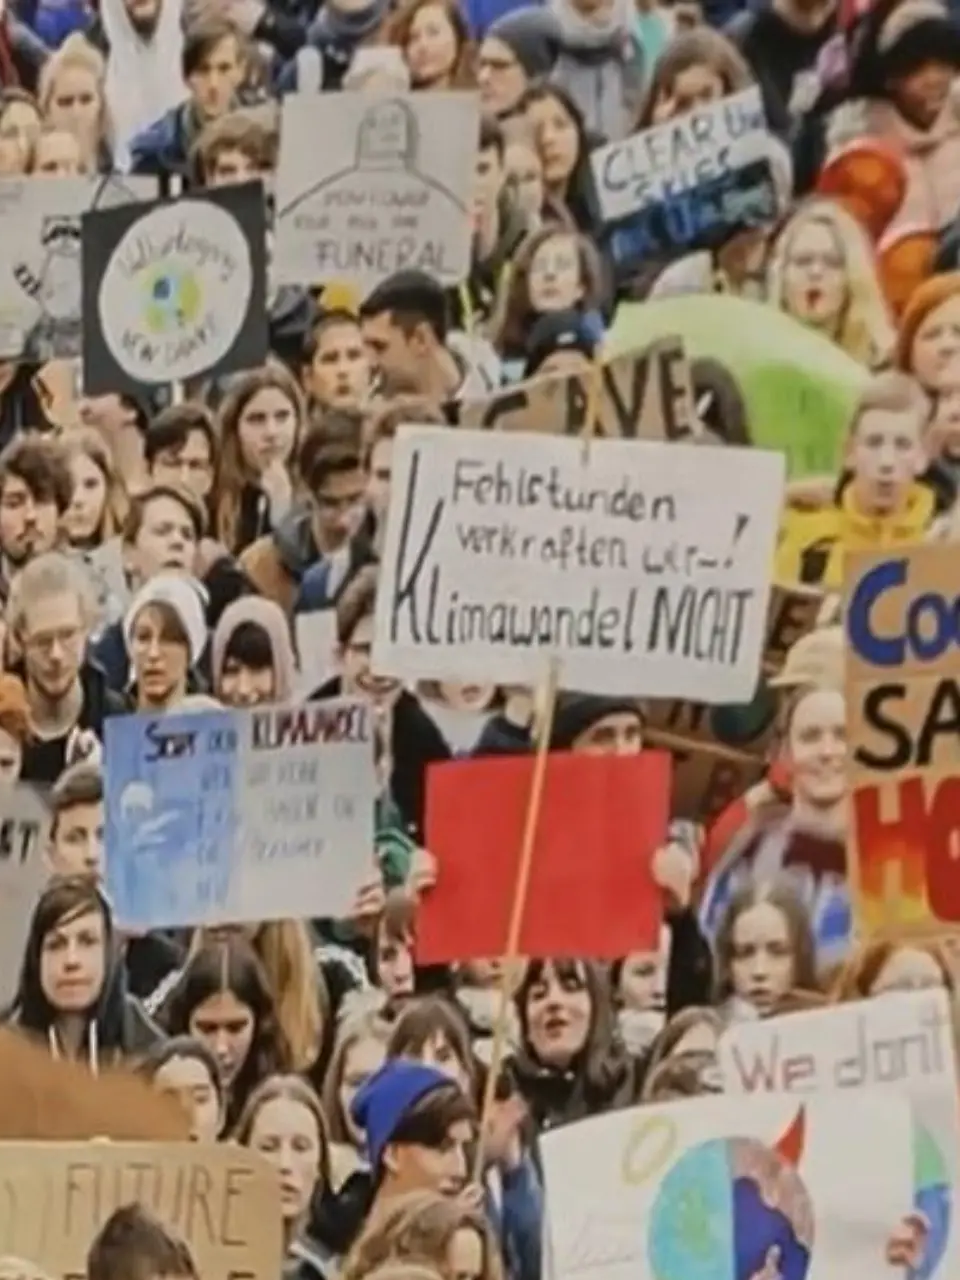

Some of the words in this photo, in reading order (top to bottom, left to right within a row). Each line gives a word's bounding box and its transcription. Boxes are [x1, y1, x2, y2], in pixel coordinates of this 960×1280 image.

[316, 238, 458, 273] FUNERAL
[452, 459, 677, 522] Fehlstunden
[390, 450, 638, 652] Klimawandel
[646, 585, 756, 665] NICHT
[457, 522, 629, 571] verkraften
[731, 1029, 817, 1095] We
[62, 1162, 256, 1248] FUTURE
